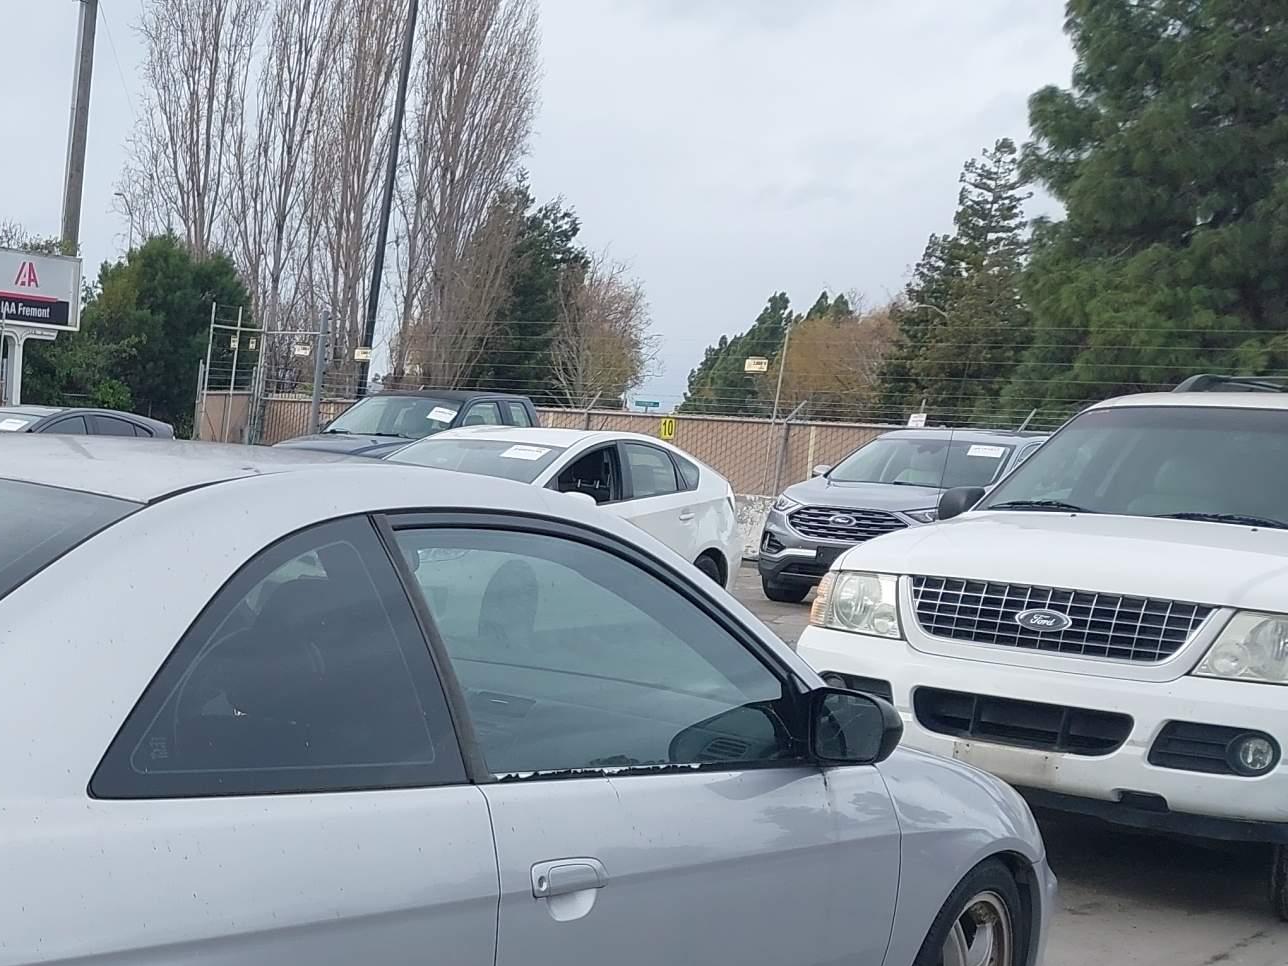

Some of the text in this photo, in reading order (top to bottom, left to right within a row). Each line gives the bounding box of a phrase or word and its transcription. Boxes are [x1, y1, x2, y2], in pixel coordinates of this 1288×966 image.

[0, 300, 50, 319] IAA Fremont
[662, 419, 674, 436] 10
[1030, 613, 1056, 626] Ford
